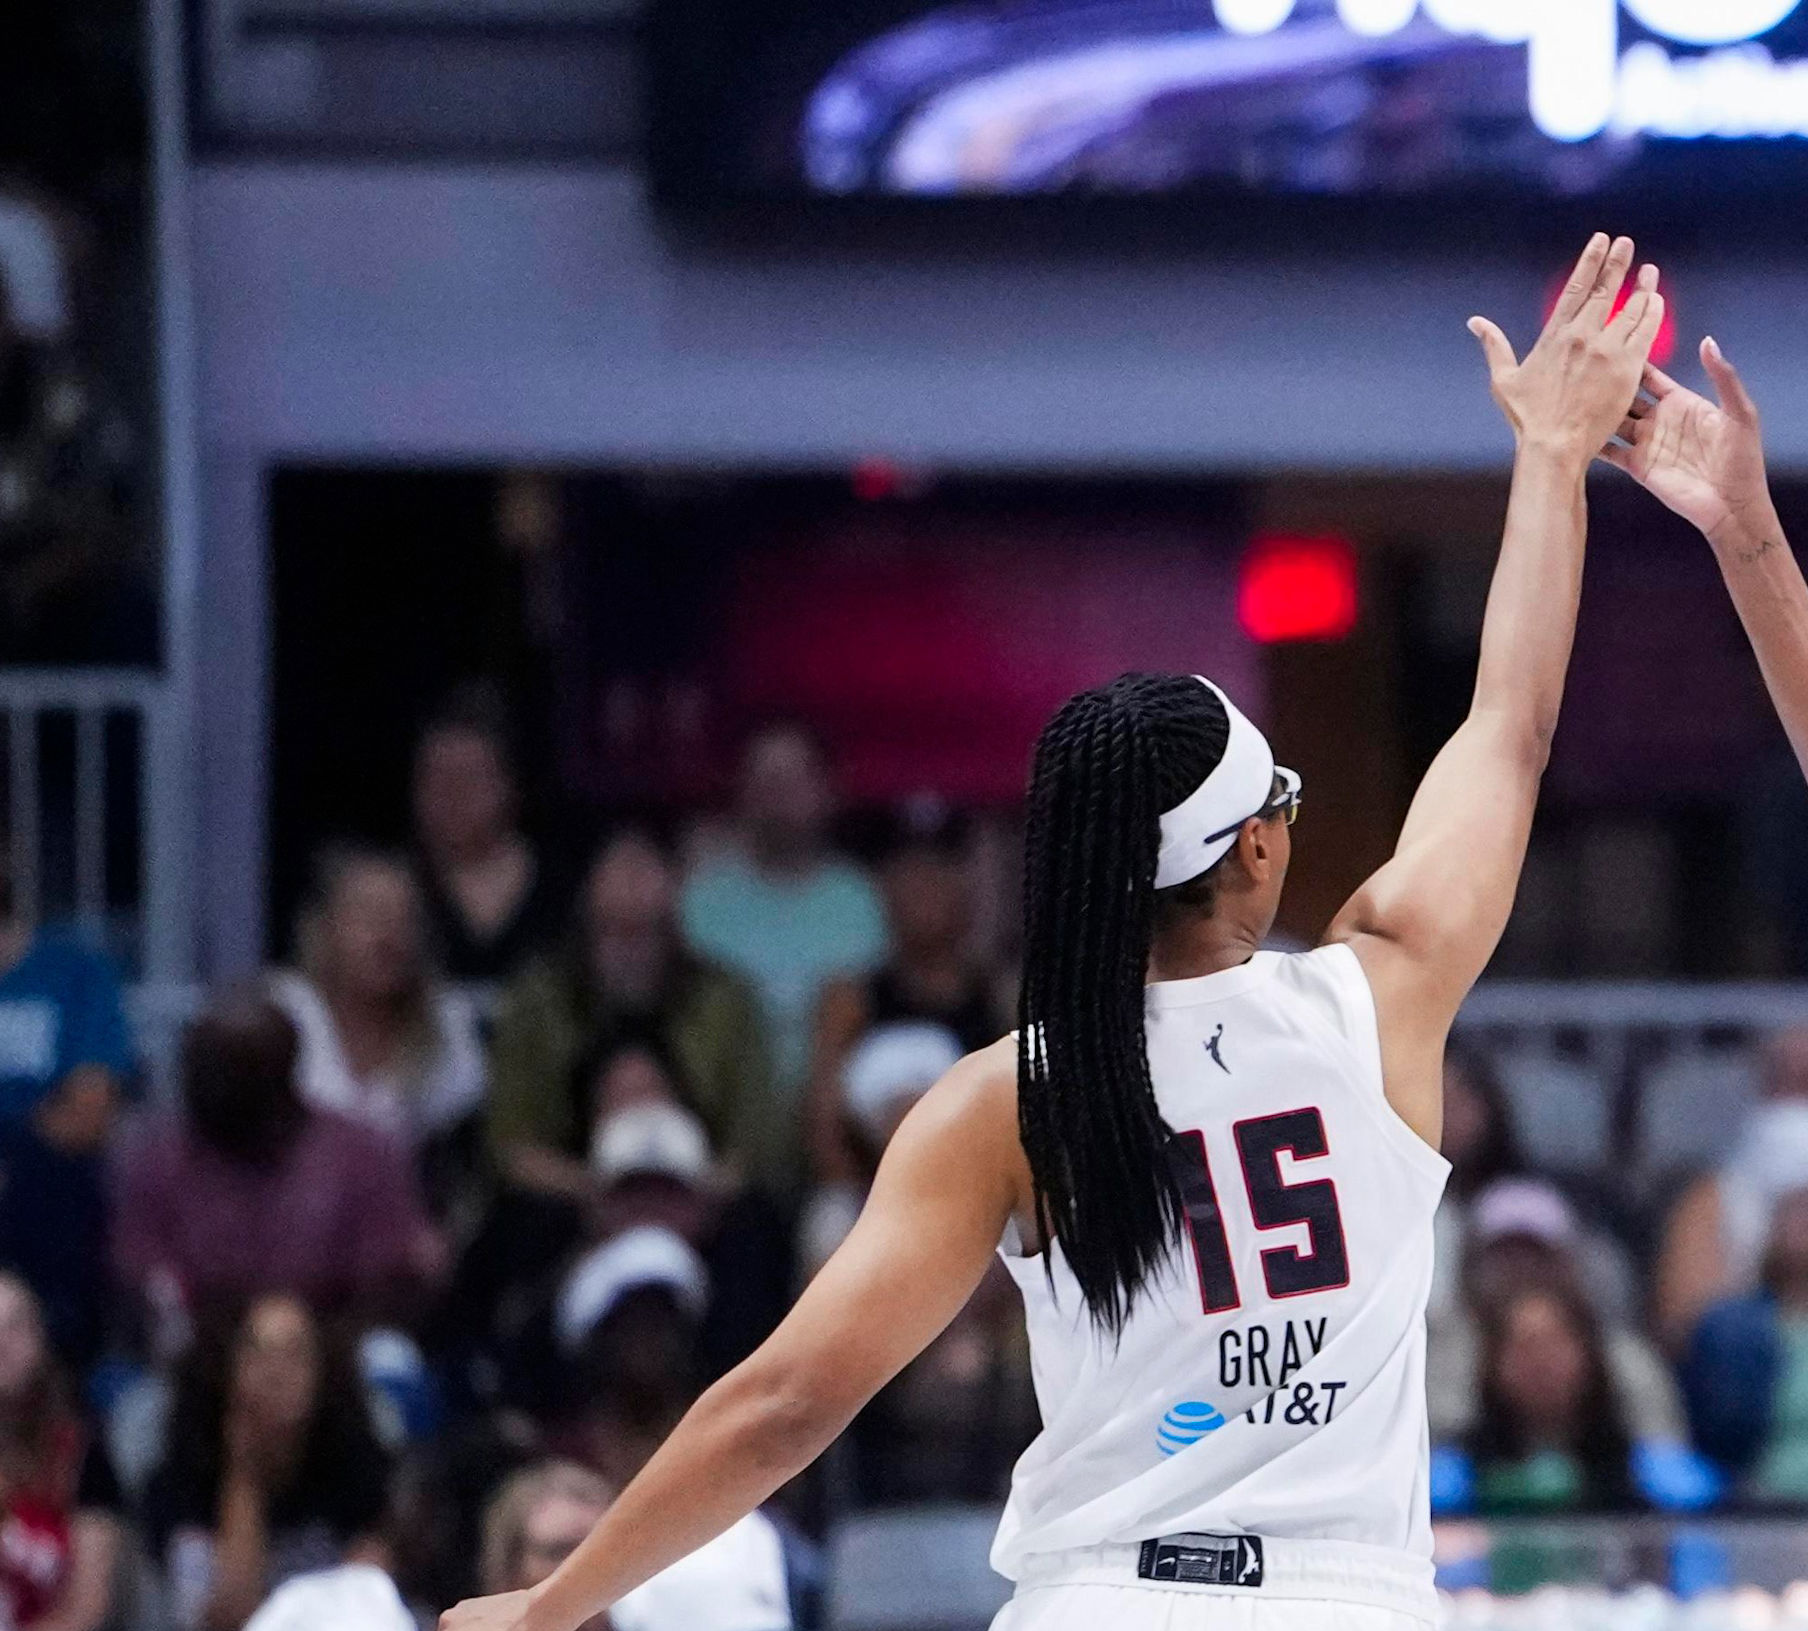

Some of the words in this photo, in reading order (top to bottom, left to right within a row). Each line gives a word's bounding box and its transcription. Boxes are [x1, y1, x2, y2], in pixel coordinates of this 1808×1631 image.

[1173, 1106, 1351, 1315] 15
[1219, 1317, 1327, 1388] GRAY
[1246, 1382, 1347, 1425] T&T
